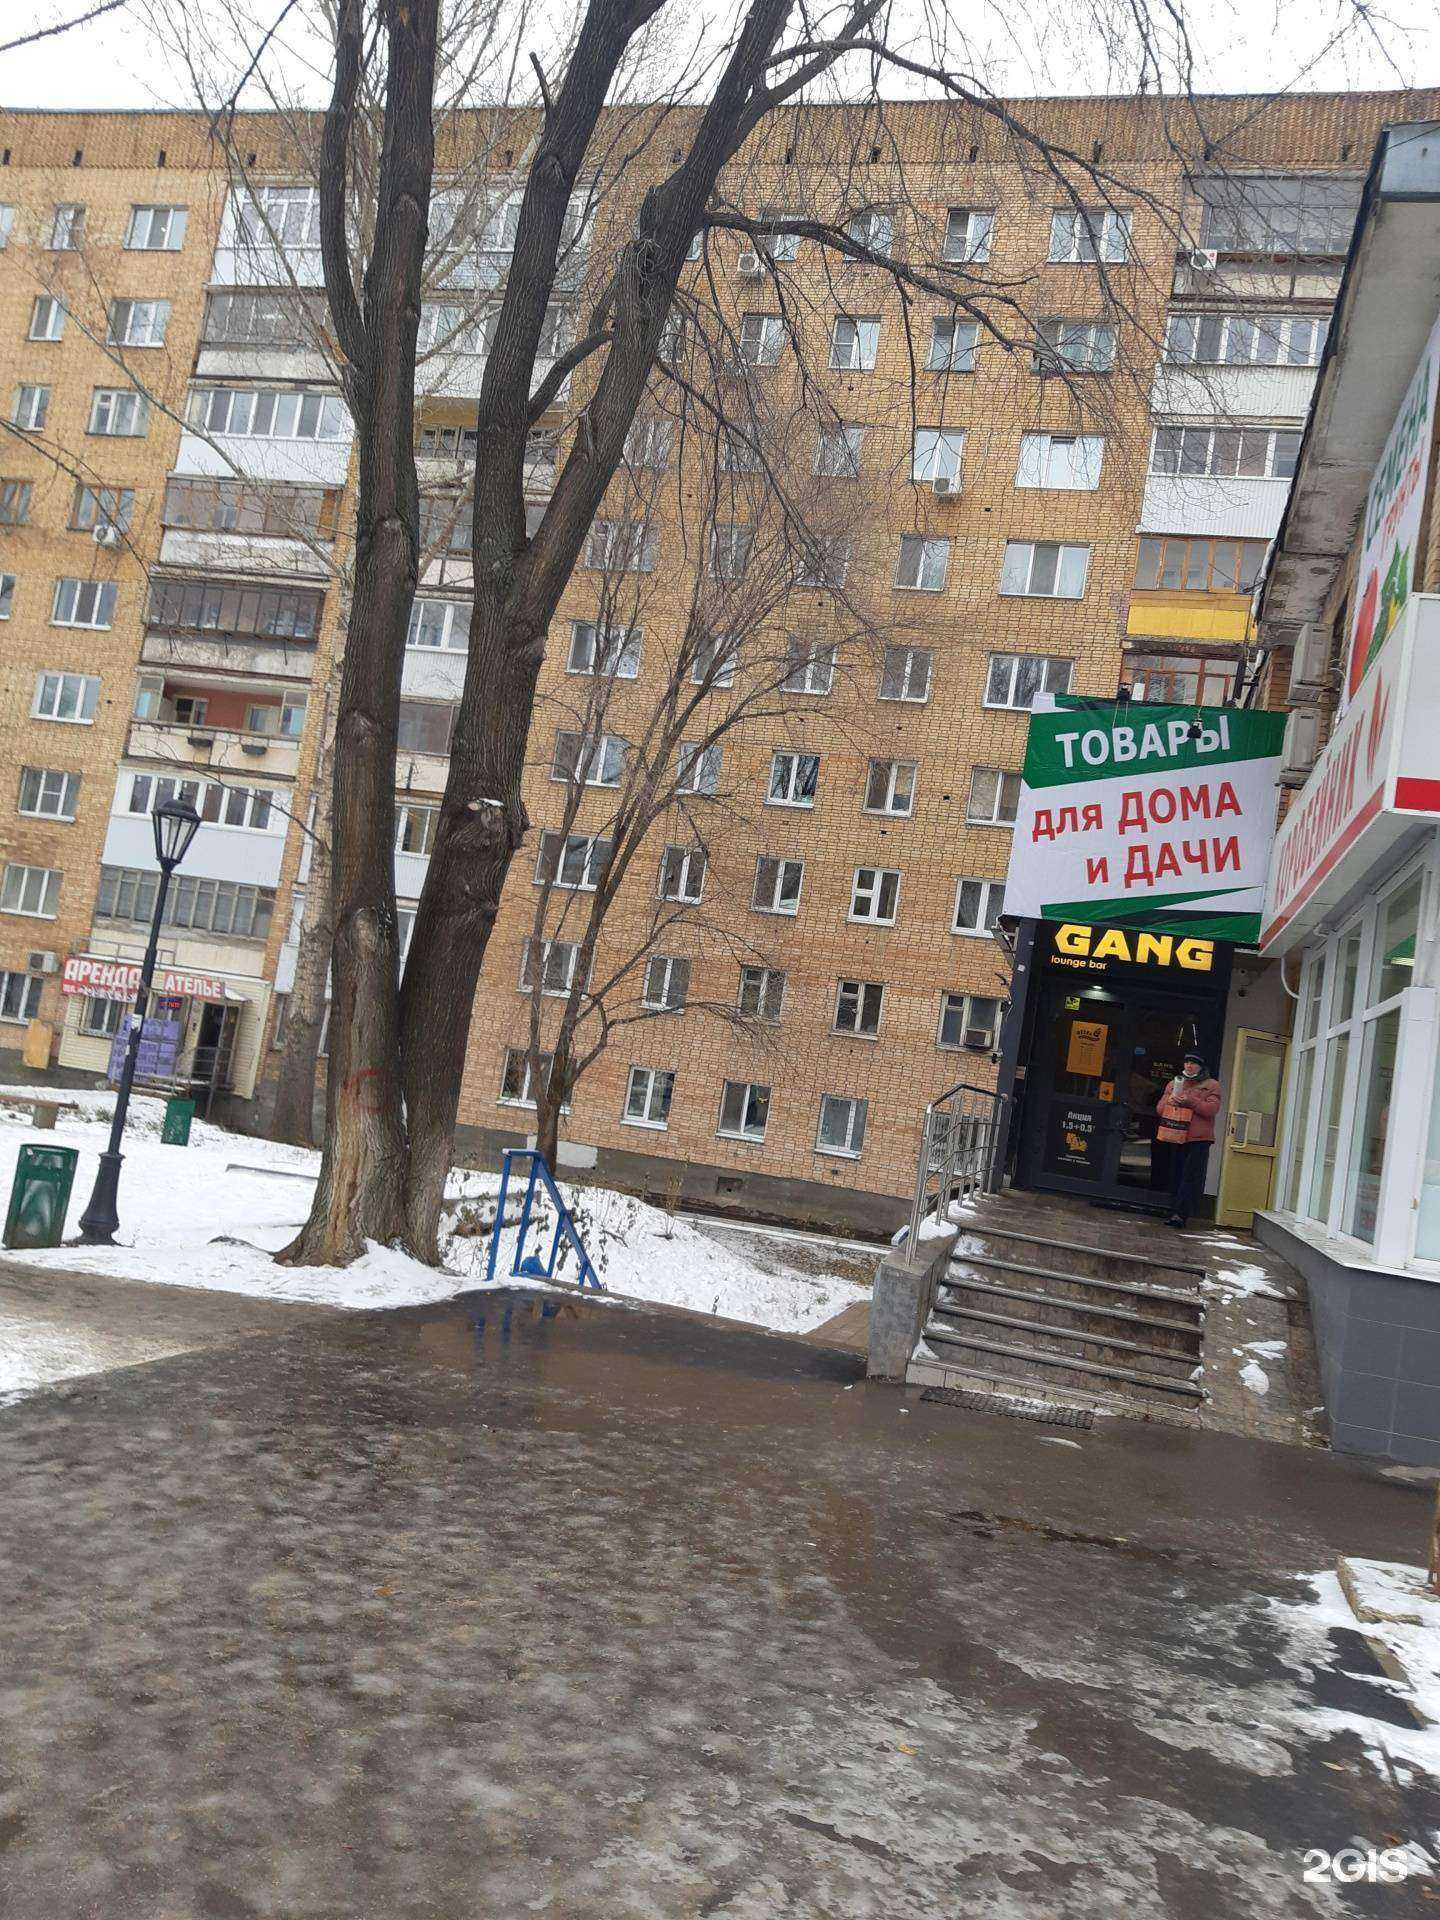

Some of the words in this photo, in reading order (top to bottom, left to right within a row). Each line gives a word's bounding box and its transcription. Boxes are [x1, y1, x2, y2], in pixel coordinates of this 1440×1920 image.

[1055, 715, 1231, 768] ТОВАРЫ
[1118, 781, 1243, 836] ДОМА
[1124, 835, 1242, 889] ДАЧИ
[1051, 955, 1087, 968] lounge
[1089, 959, 1108, 970] bar
[1055, 923, 1214, 971] GANG
[64, 958, 143, 990] АРЕНДА
[165, 974, 222, 998] АТЕЛЬЕ
